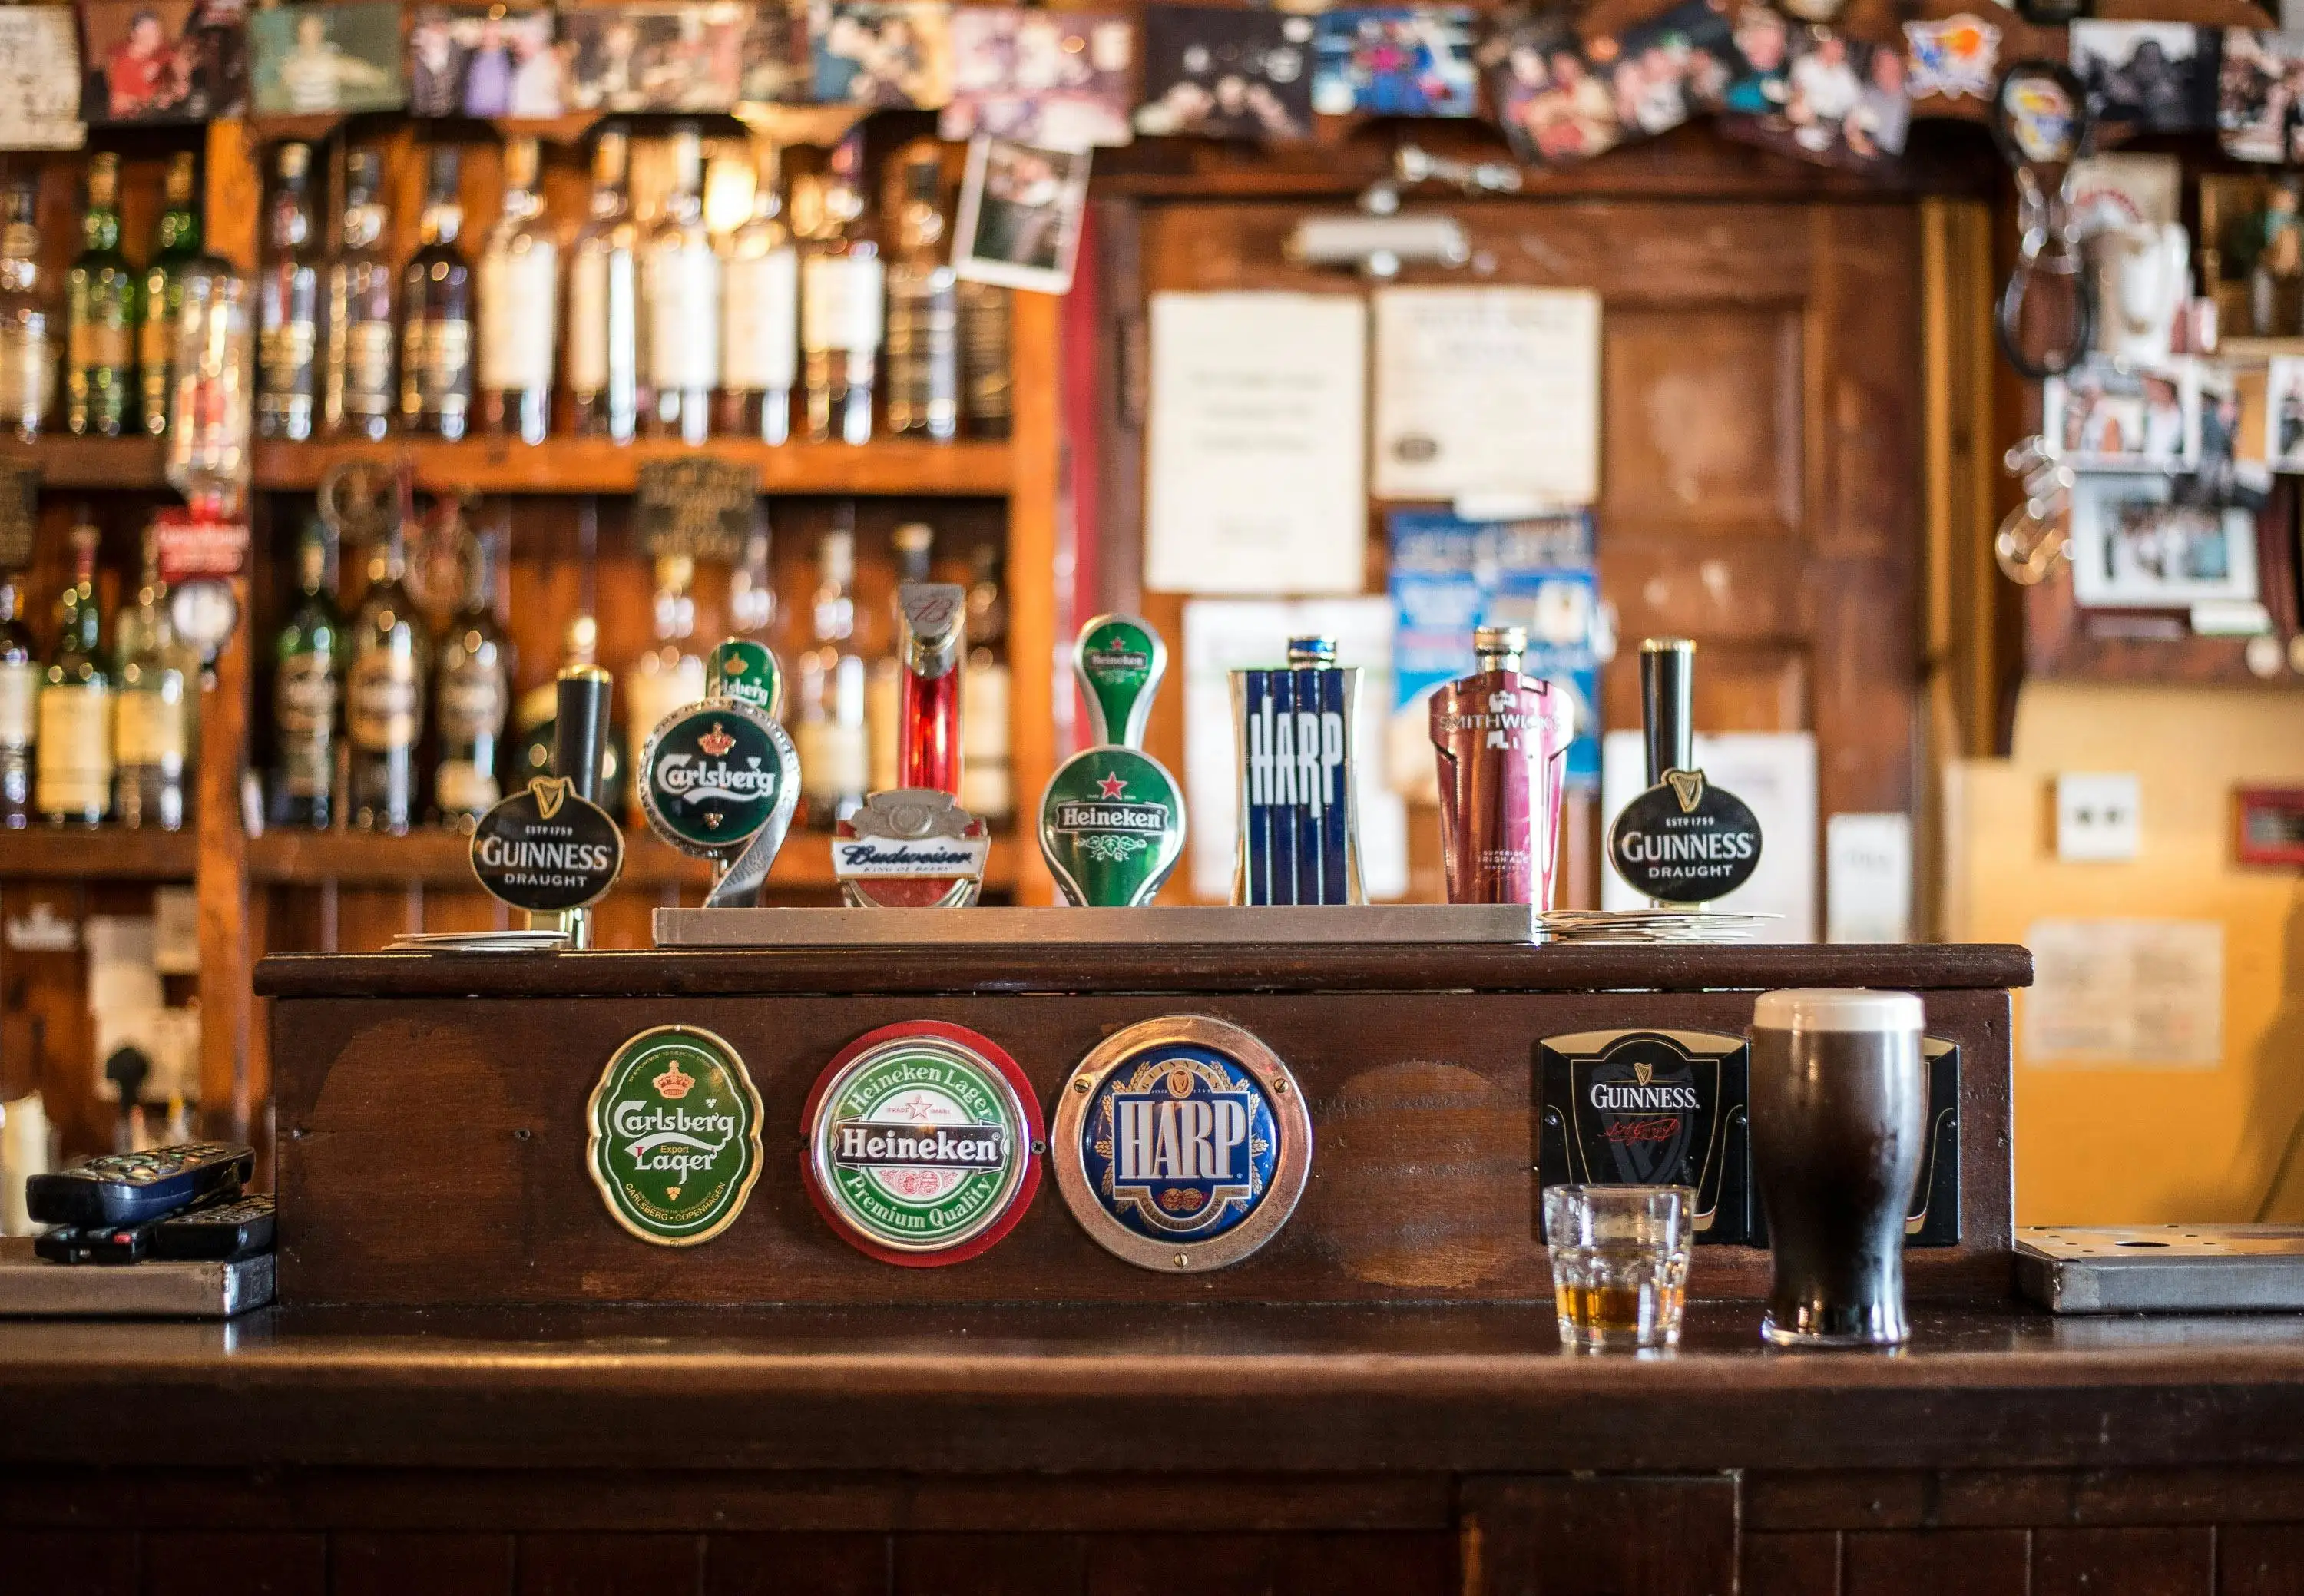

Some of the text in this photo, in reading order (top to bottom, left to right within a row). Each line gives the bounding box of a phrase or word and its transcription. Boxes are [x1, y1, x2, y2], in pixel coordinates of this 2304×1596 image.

[1250, 695, 1343, 819] HARP
[657, 753, 776, 803] Carlsberg
[1064, 807, 1160, 828] Heineken
[482, 835, 608, 871] GUINNESS
[842, 845, 973, 866] Budweiser
[1621, 831, 1752, 862] GUINNESS
[504, 873, 588, 887] DRAUGHT
[1649, 864, 1733, 878] DRAUGHT
[848, 1064, 994, 1118] Heineken Lager
[1591, 1084, 1696, 1108] GUINNESS
[614, 1099, 735, 1152] Carlsberg
[1118, 1100, 1246, 1180] HARP
[660, 1145, 689, 1154] Export
[842, 1128, 998, 1161] Heineken
[634, 1147, 717, 1184] Lager
[626, 1183, 667, 1220] CARLSBERG
[676, 1182, 726, 1221] COPENHAGEN
[846, 1174, 925, 1228] Premium
[929, 1177, 994, 1227] Quality
